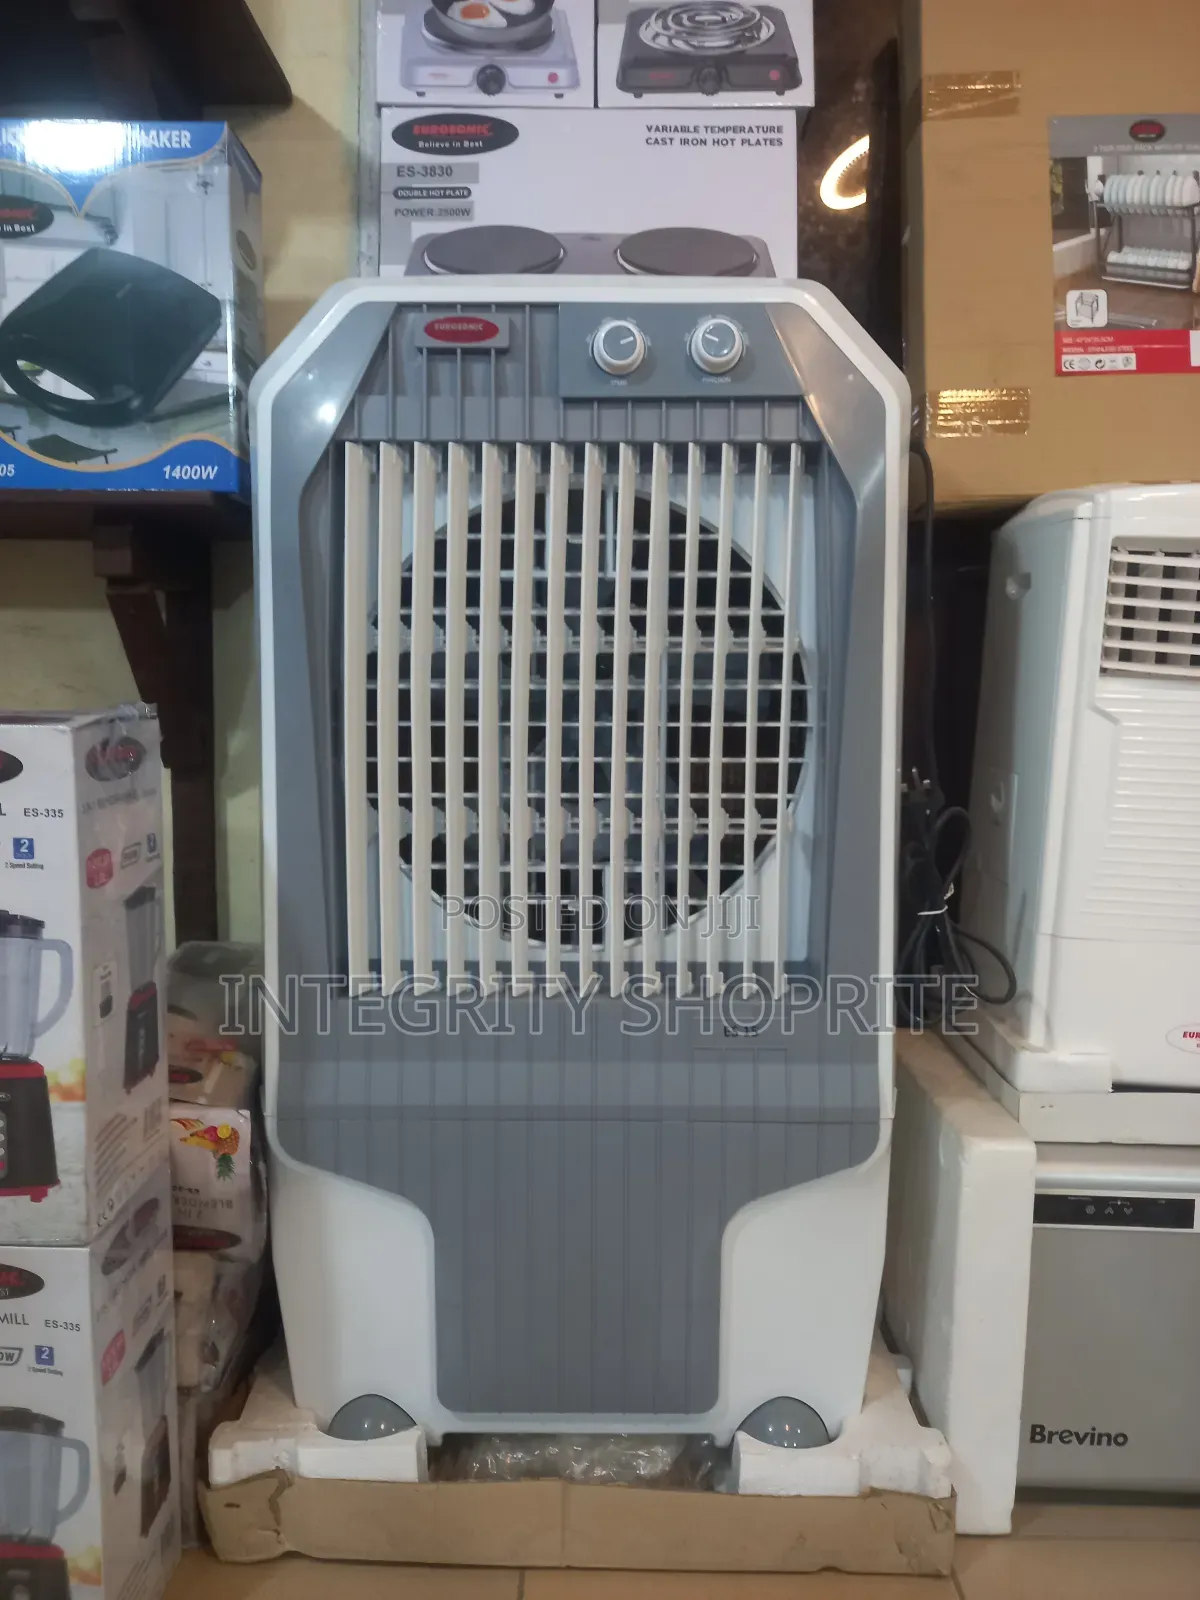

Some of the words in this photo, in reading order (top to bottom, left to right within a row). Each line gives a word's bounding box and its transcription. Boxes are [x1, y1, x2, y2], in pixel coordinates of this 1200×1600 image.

[412, 122, 495, 137] EUROSONIC
[645, 124, 701, 134] VARIABLE
[703, 124, 784, 135] TEMPERATURE
[418, 140, 450, 149] Believe
[463, 140, 484, 149] Best
[645, 136, 675, 147] CAST
[679, 137, 708, 147] IRON
[712, 138, 737, 147] HOT
[741, 138, 784, 147] PLATES
[396, 165, 453, 178] ES-3830
[397, 188, 428, 198] DOUBLE
[429, 188, 444, 197] HOT
[445, 188, 469, 198] PLATE
[14, 223, 36, 233] Best
[433, 322, 484, 332] EUROSONIC
[162, 464, 219, 481] 1400W
[23, 807, 64, 819] ES-335
[20, 838, 29, 853] 2
[44, 1318, 81, 1333] ES-335
[40, 1346, 50, 1360] 2
[1029, 1423, 1129, 1447] Brevino
